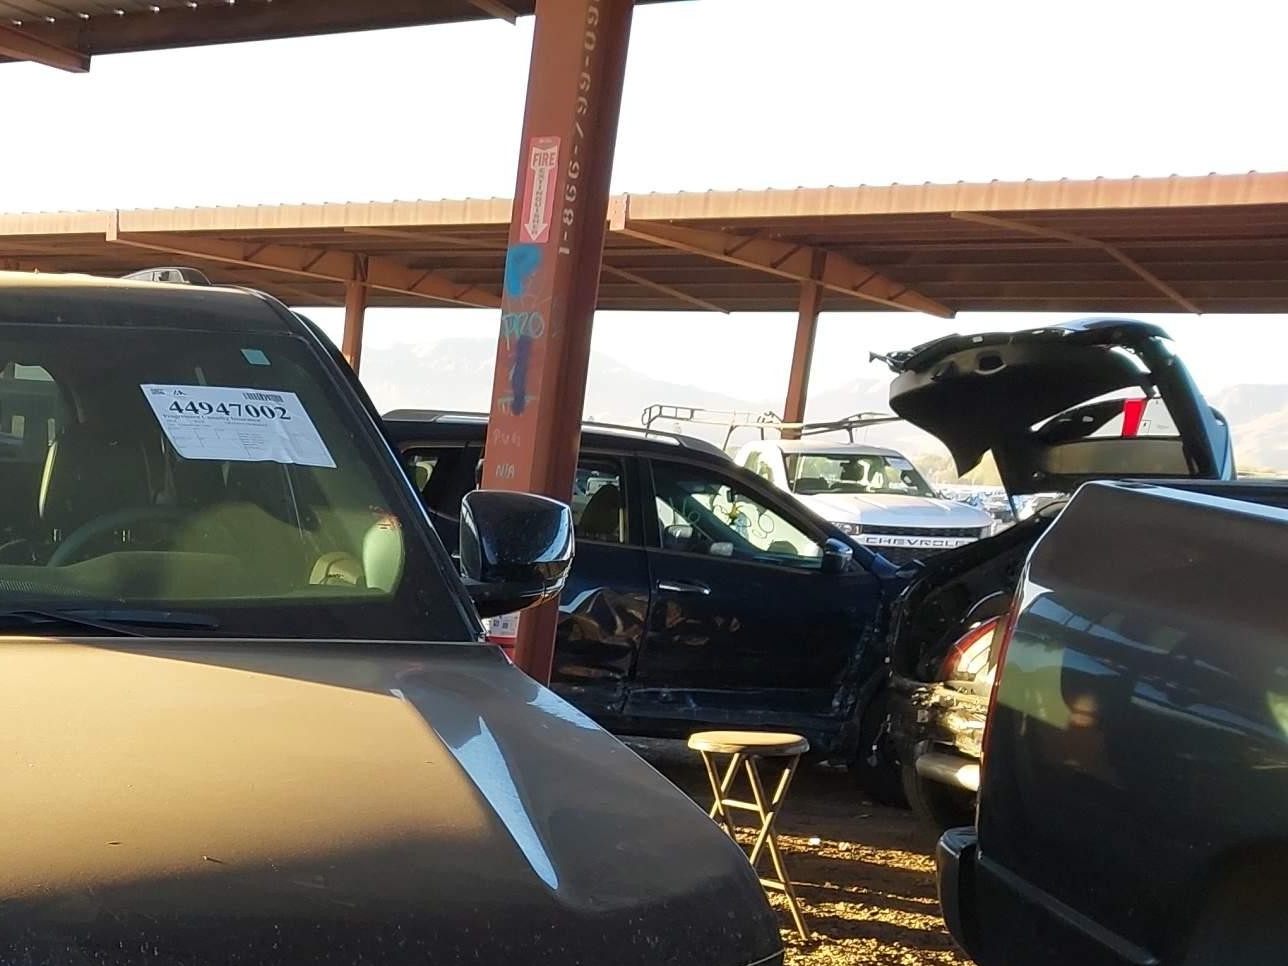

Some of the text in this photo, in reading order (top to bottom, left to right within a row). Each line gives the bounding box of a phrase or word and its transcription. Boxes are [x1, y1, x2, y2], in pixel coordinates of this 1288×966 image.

[559, 0, 600, 255] 1-866-799-09
[532, 151, 557, 168] FIRE
[169, 400, 291, 420] 44947002
[865, 537, 967, 547] CHEVROLE
